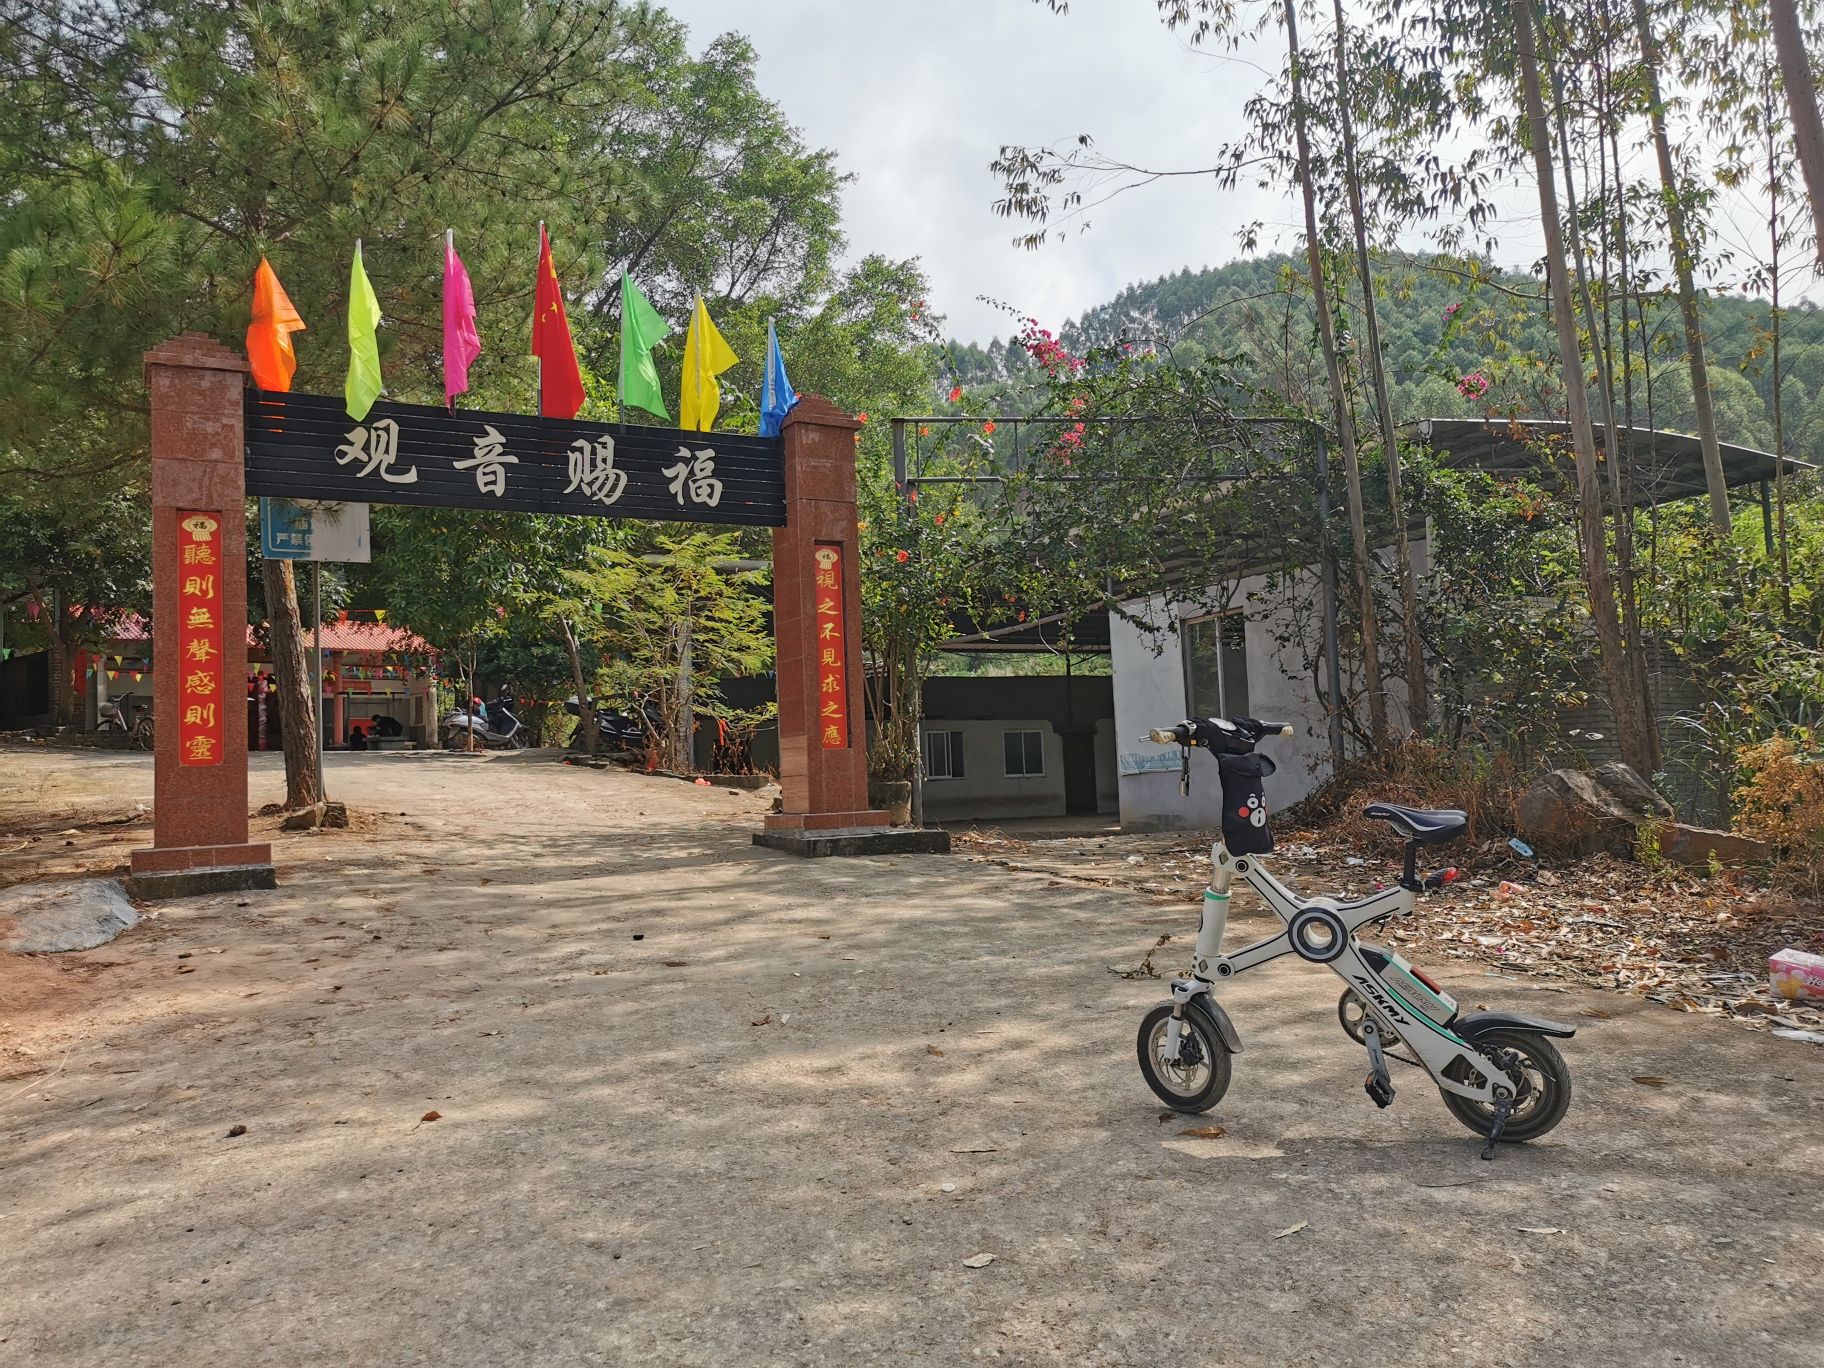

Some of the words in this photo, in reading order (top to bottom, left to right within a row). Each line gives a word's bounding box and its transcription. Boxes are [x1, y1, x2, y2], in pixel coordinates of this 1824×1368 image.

[335, 418, 724, 508] 观音赐福
[183, 543, 218, 760] 聽則無聲感則靈
[816, 571, 844, 745] 視之不見求之應
[1351, 974, 1411, 1026] ASKMY
